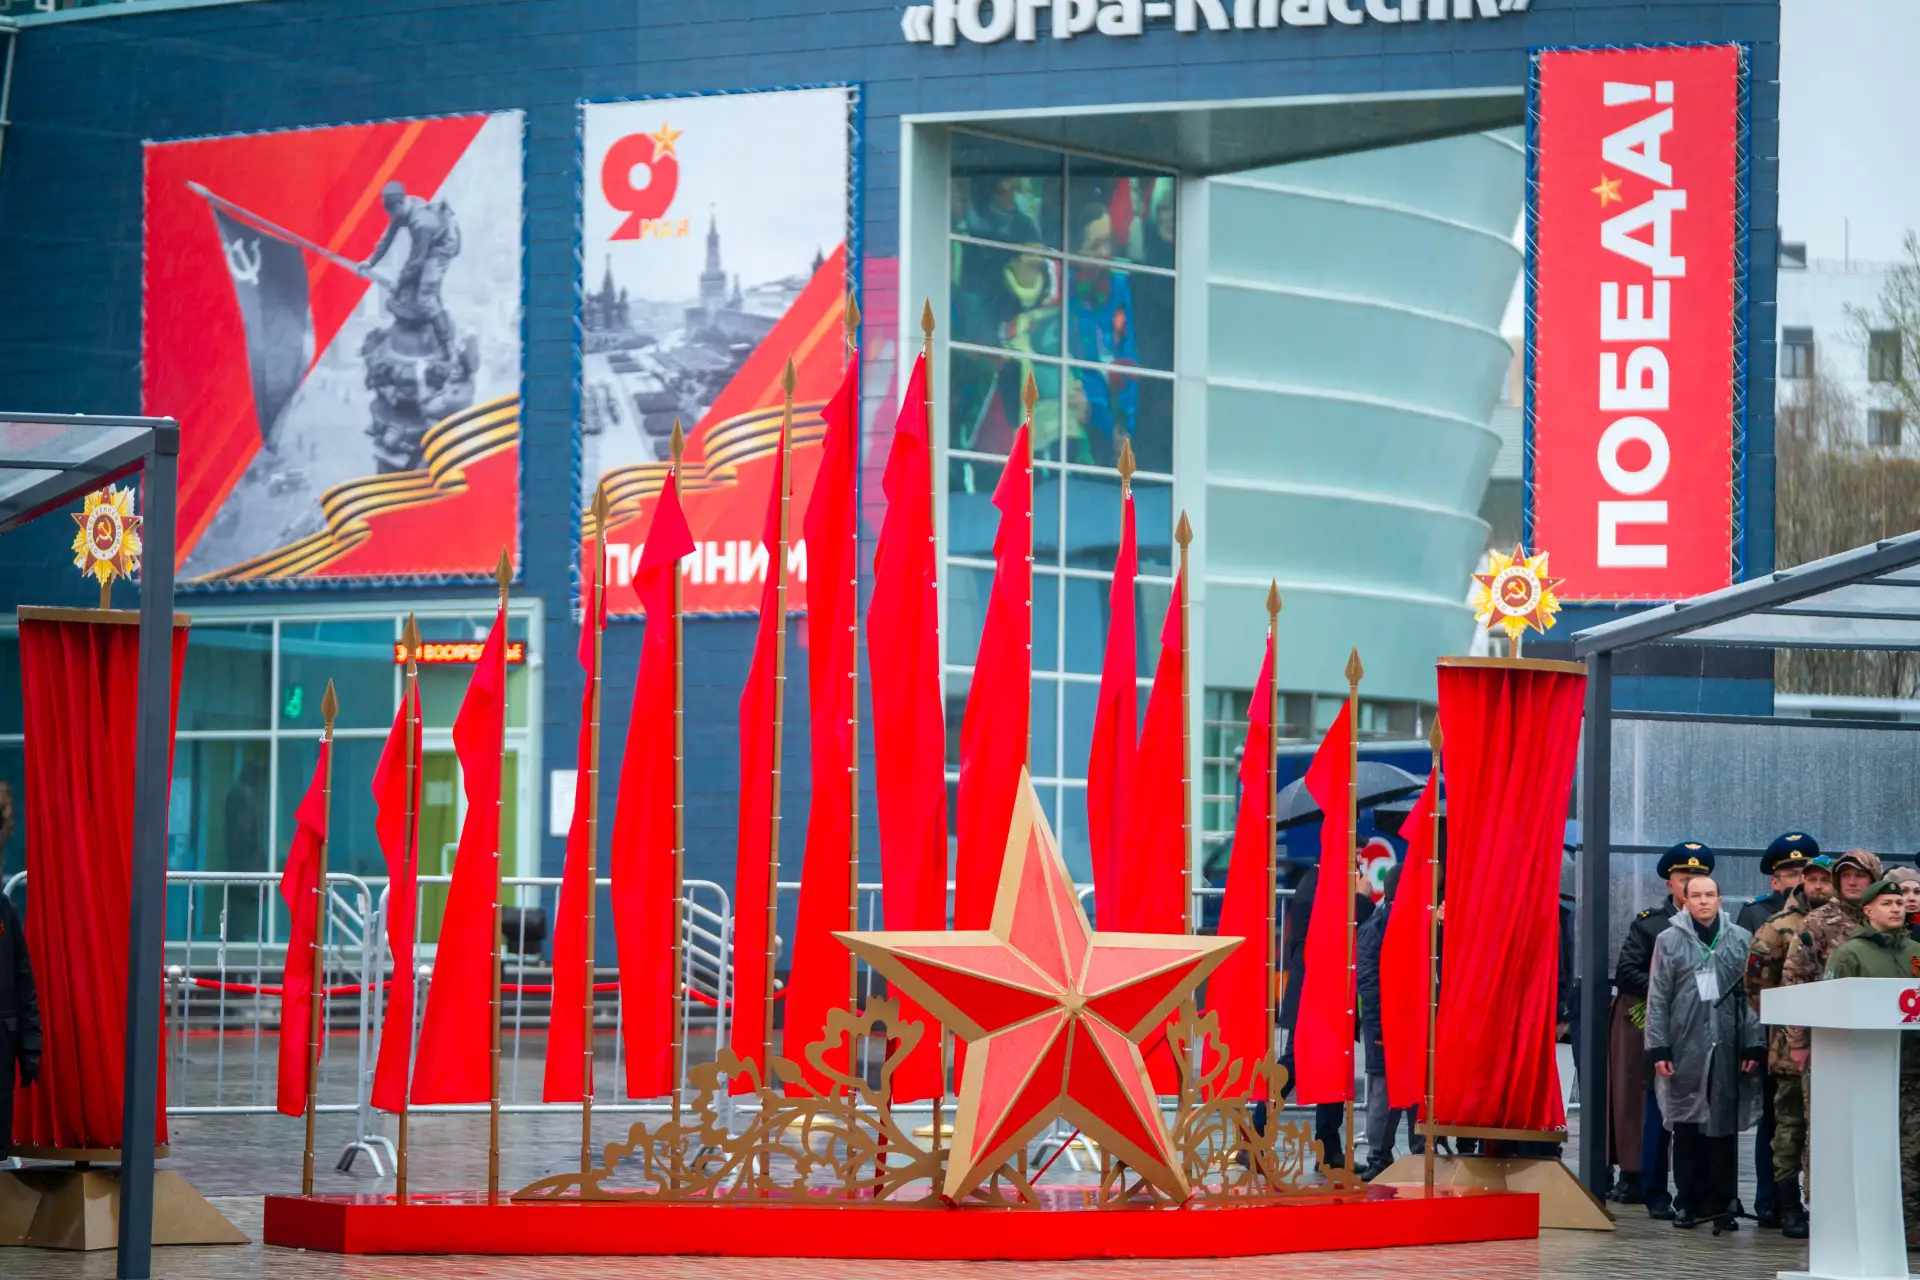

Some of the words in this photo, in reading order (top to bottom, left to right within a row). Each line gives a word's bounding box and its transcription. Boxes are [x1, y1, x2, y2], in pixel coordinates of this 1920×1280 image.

[601, 132, 679, 241] 9
[641, 218, 689, 239] МАЯ
[1597, 80, 1687, 567] ПОБЕДА!
[605, 539, 808, 587] ПНИМ
